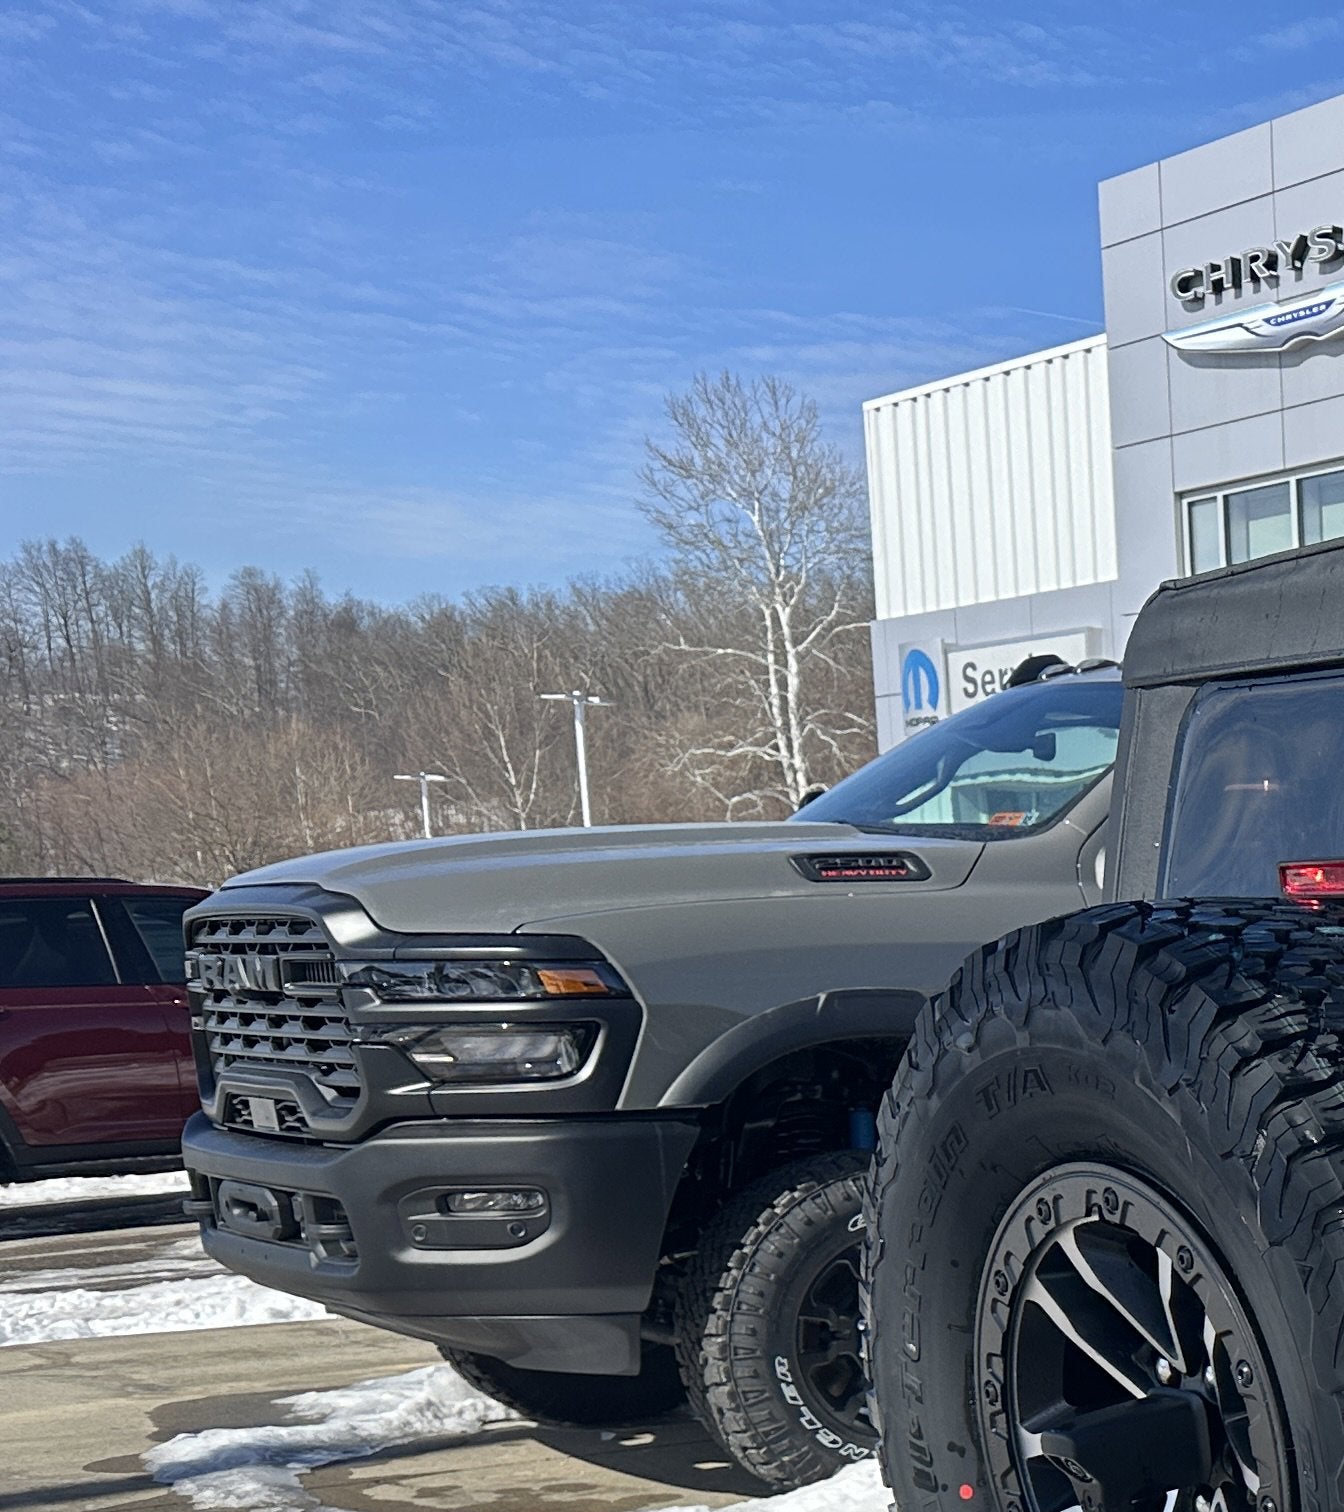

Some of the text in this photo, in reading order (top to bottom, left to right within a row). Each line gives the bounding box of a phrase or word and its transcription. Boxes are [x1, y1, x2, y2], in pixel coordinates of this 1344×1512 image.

[1269, 304, 1327, 325] CHRYSLER
[962, 661, 1014, 698] Ser
[813, 857, 900, 869] 2500
[821, 868, 867, 878] HEAVY
[199, 954, 282, 992] RAM
[774, 1355, 872, 1461] NGLER
